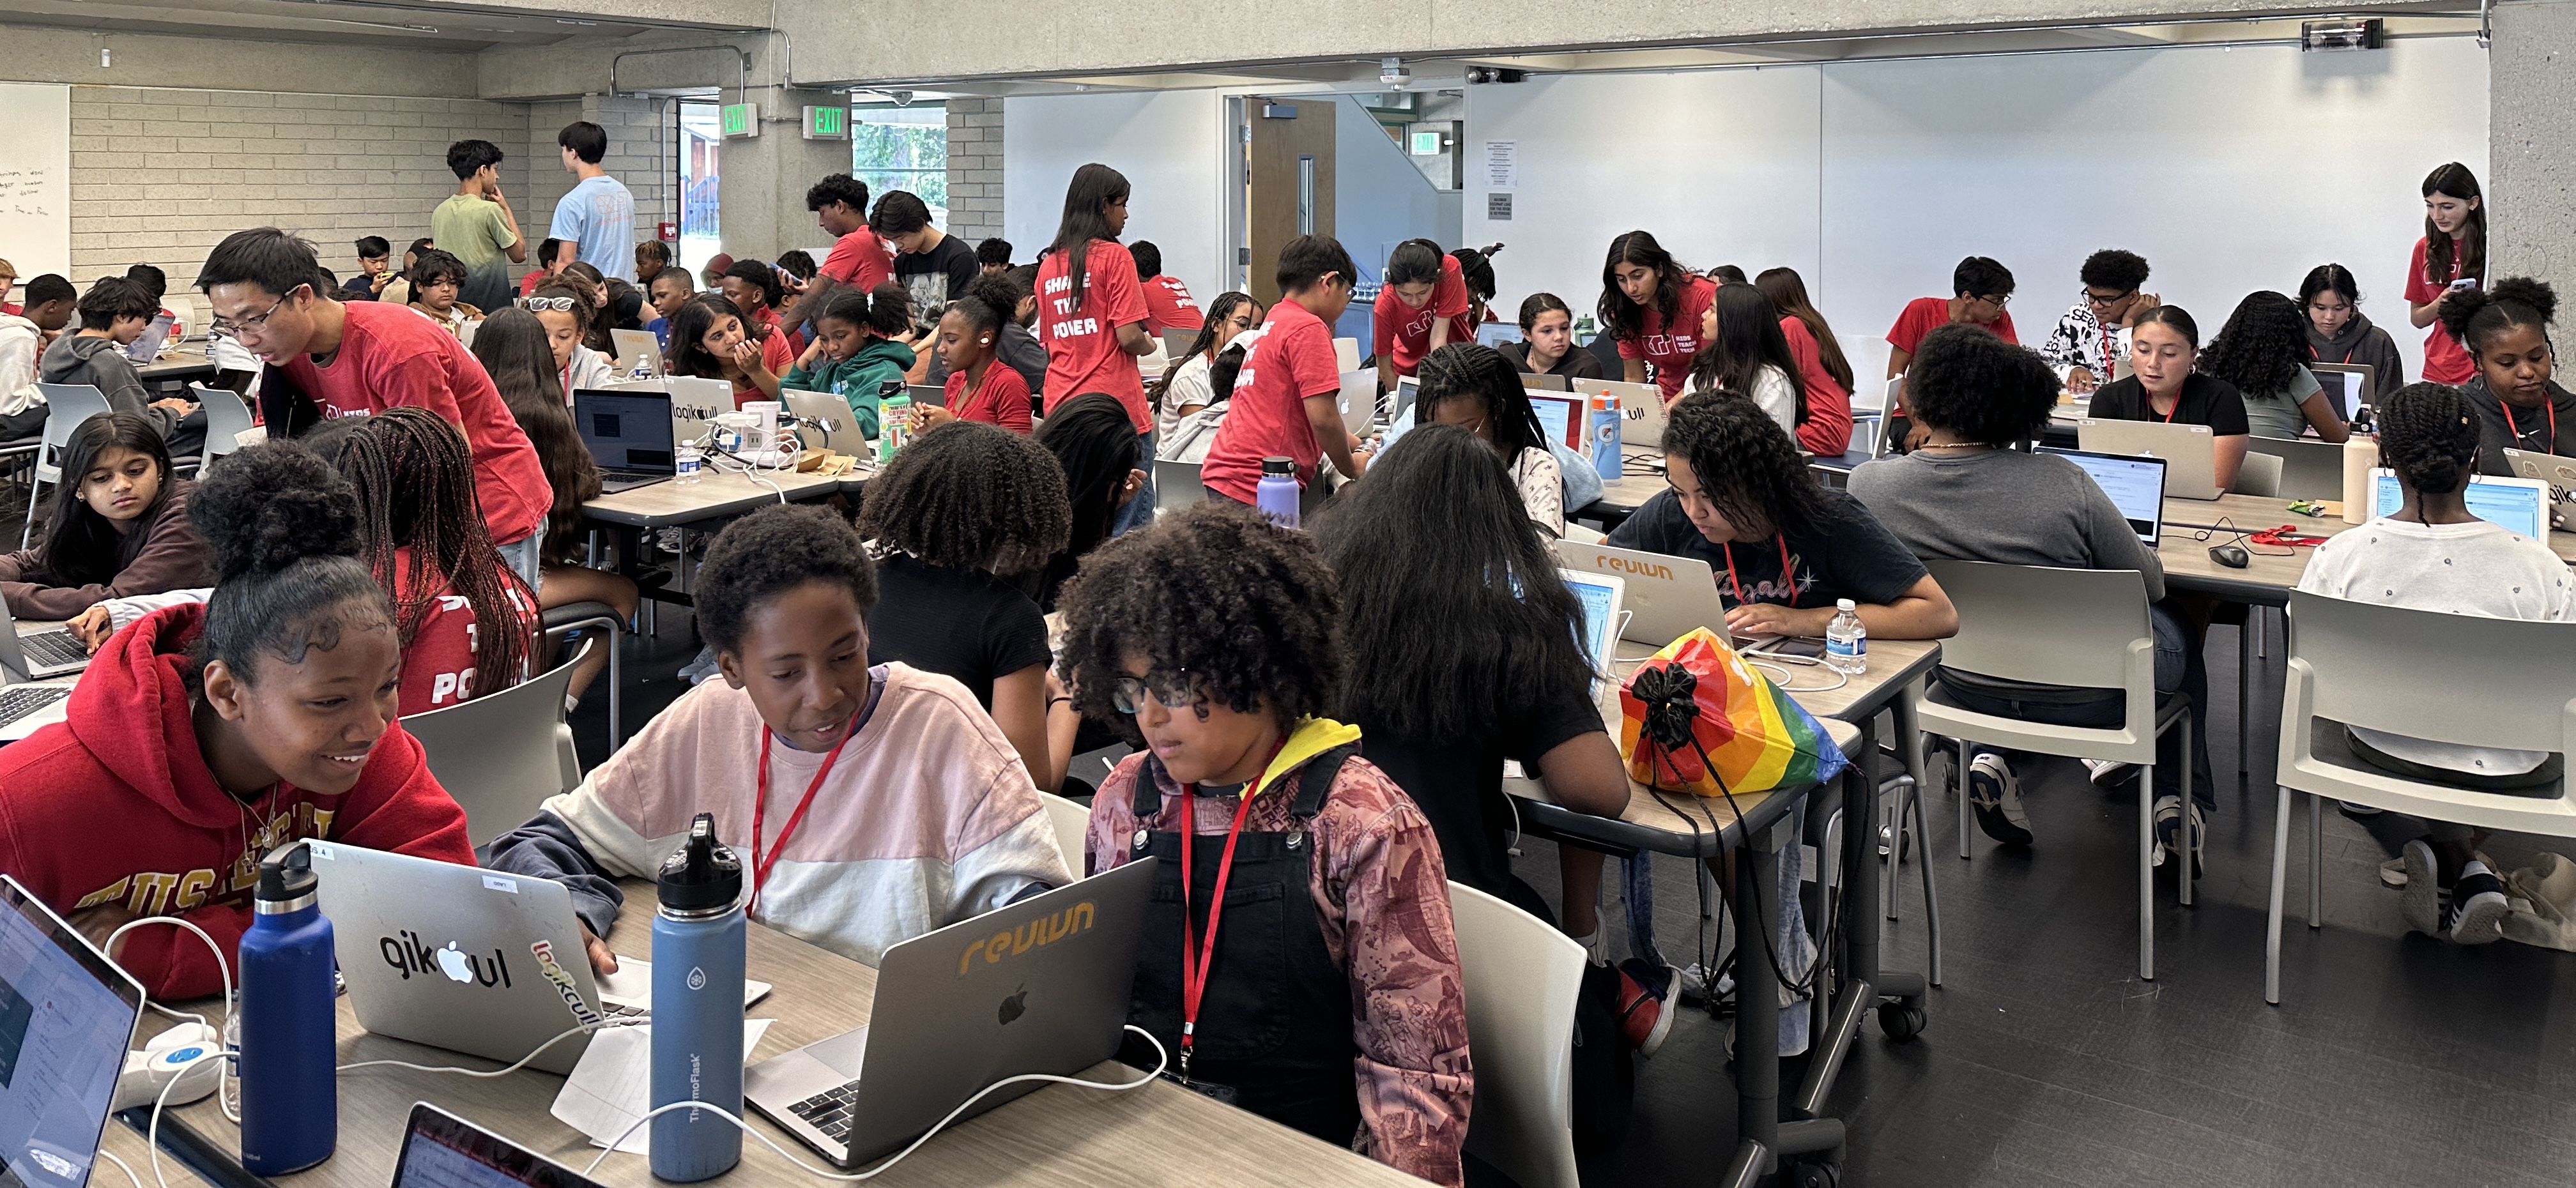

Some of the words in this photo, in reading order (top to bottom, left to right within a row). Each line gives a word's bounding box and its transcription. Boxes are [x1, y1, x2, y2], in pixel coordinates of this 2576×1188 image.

[724, 105, 746, 133] EXIT
[815, 107, 843, 133] EXIT
[1416, 134, 1434, 151] EXIT
[1045, 271, 1091, 296] SHAE
[1053, 296, 1081, 316] TH
